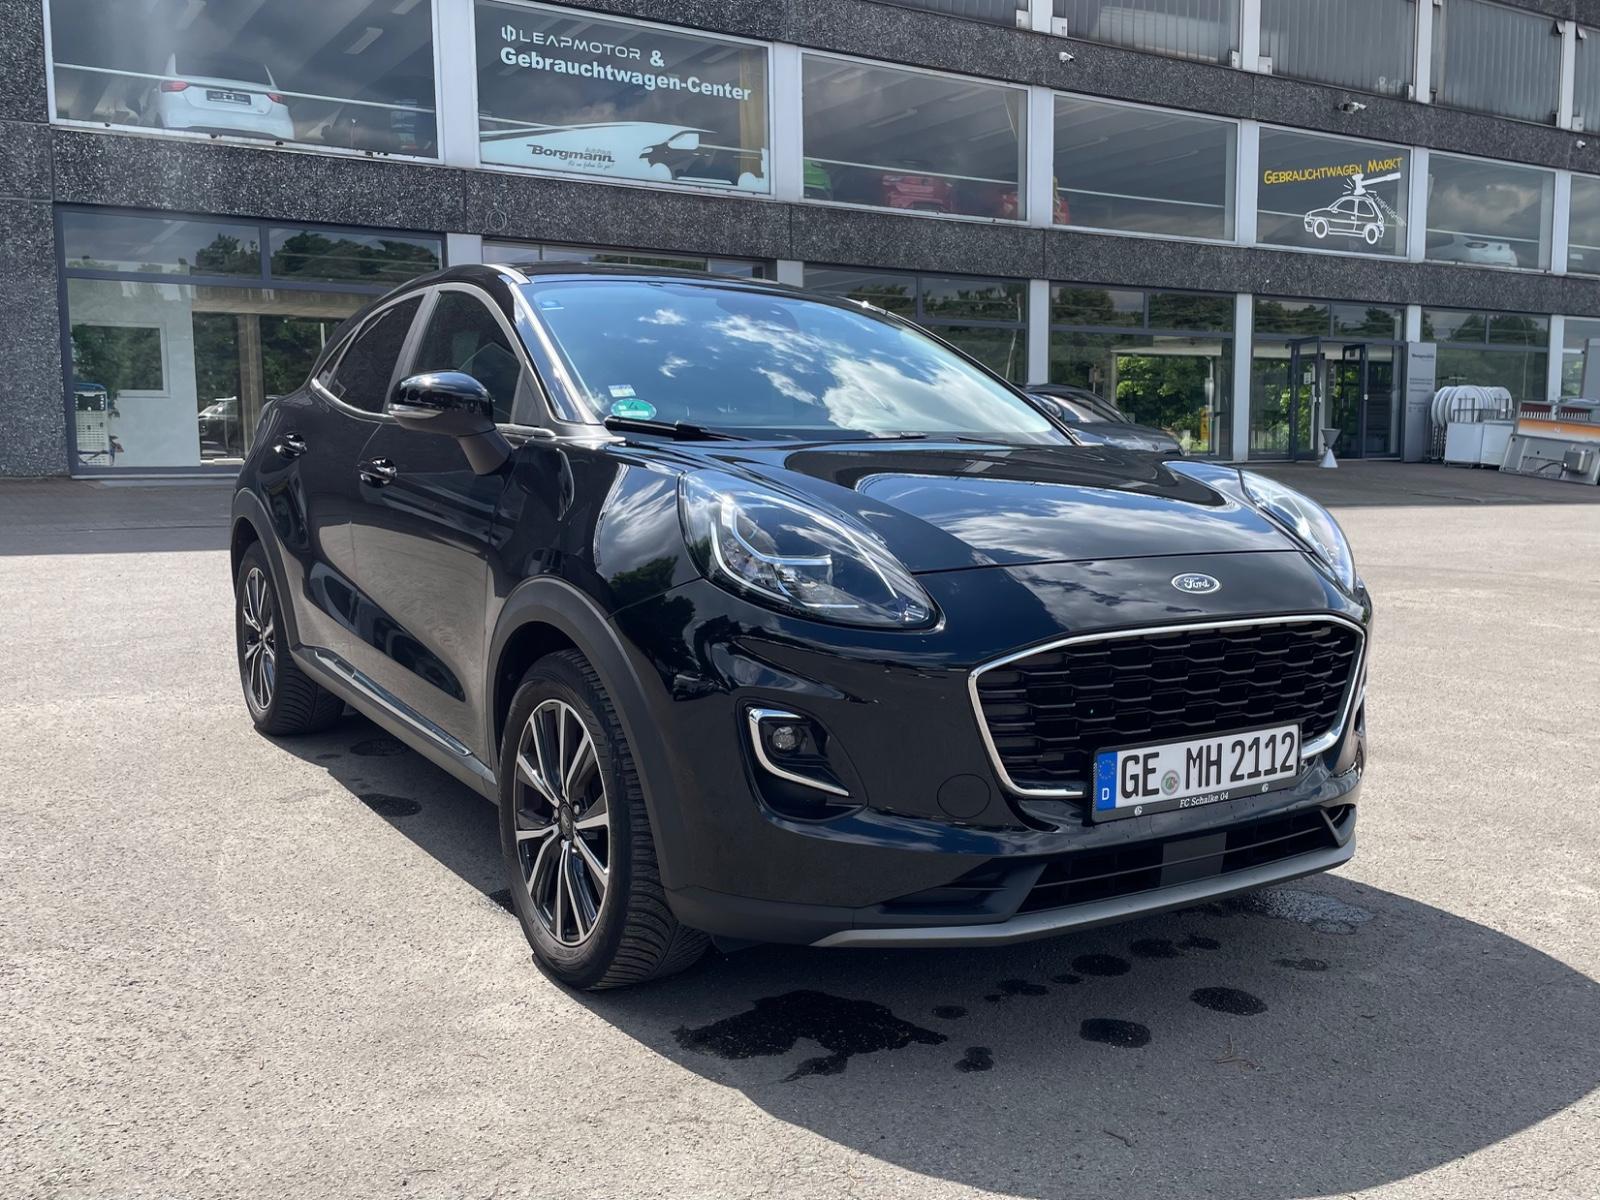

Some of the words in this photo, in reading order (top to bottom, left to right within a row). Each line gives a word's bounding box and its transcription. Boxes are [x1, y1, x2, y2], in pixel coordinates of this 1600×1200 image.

[519, 32, 641, 60] LEAPMOTOR
[649, 50, 665, 68] &
[500, 47, 752, 101] Gebrauchtwagen-Center
[526, 144, 616, 163] Borgmann
[1183, 577, 1210, 589] Ford
[1120, 752, 1160, 799] GE
[1185, 743, 1223, 790] MH
[1230, 731, 1295, 783] 2112
[1102, 788, 1110, 800] D
[1179, 798, 1190, 808] FC
[1190, 793, 1219, 806] Schalke
[1220, 791, 1229, 801] 04
